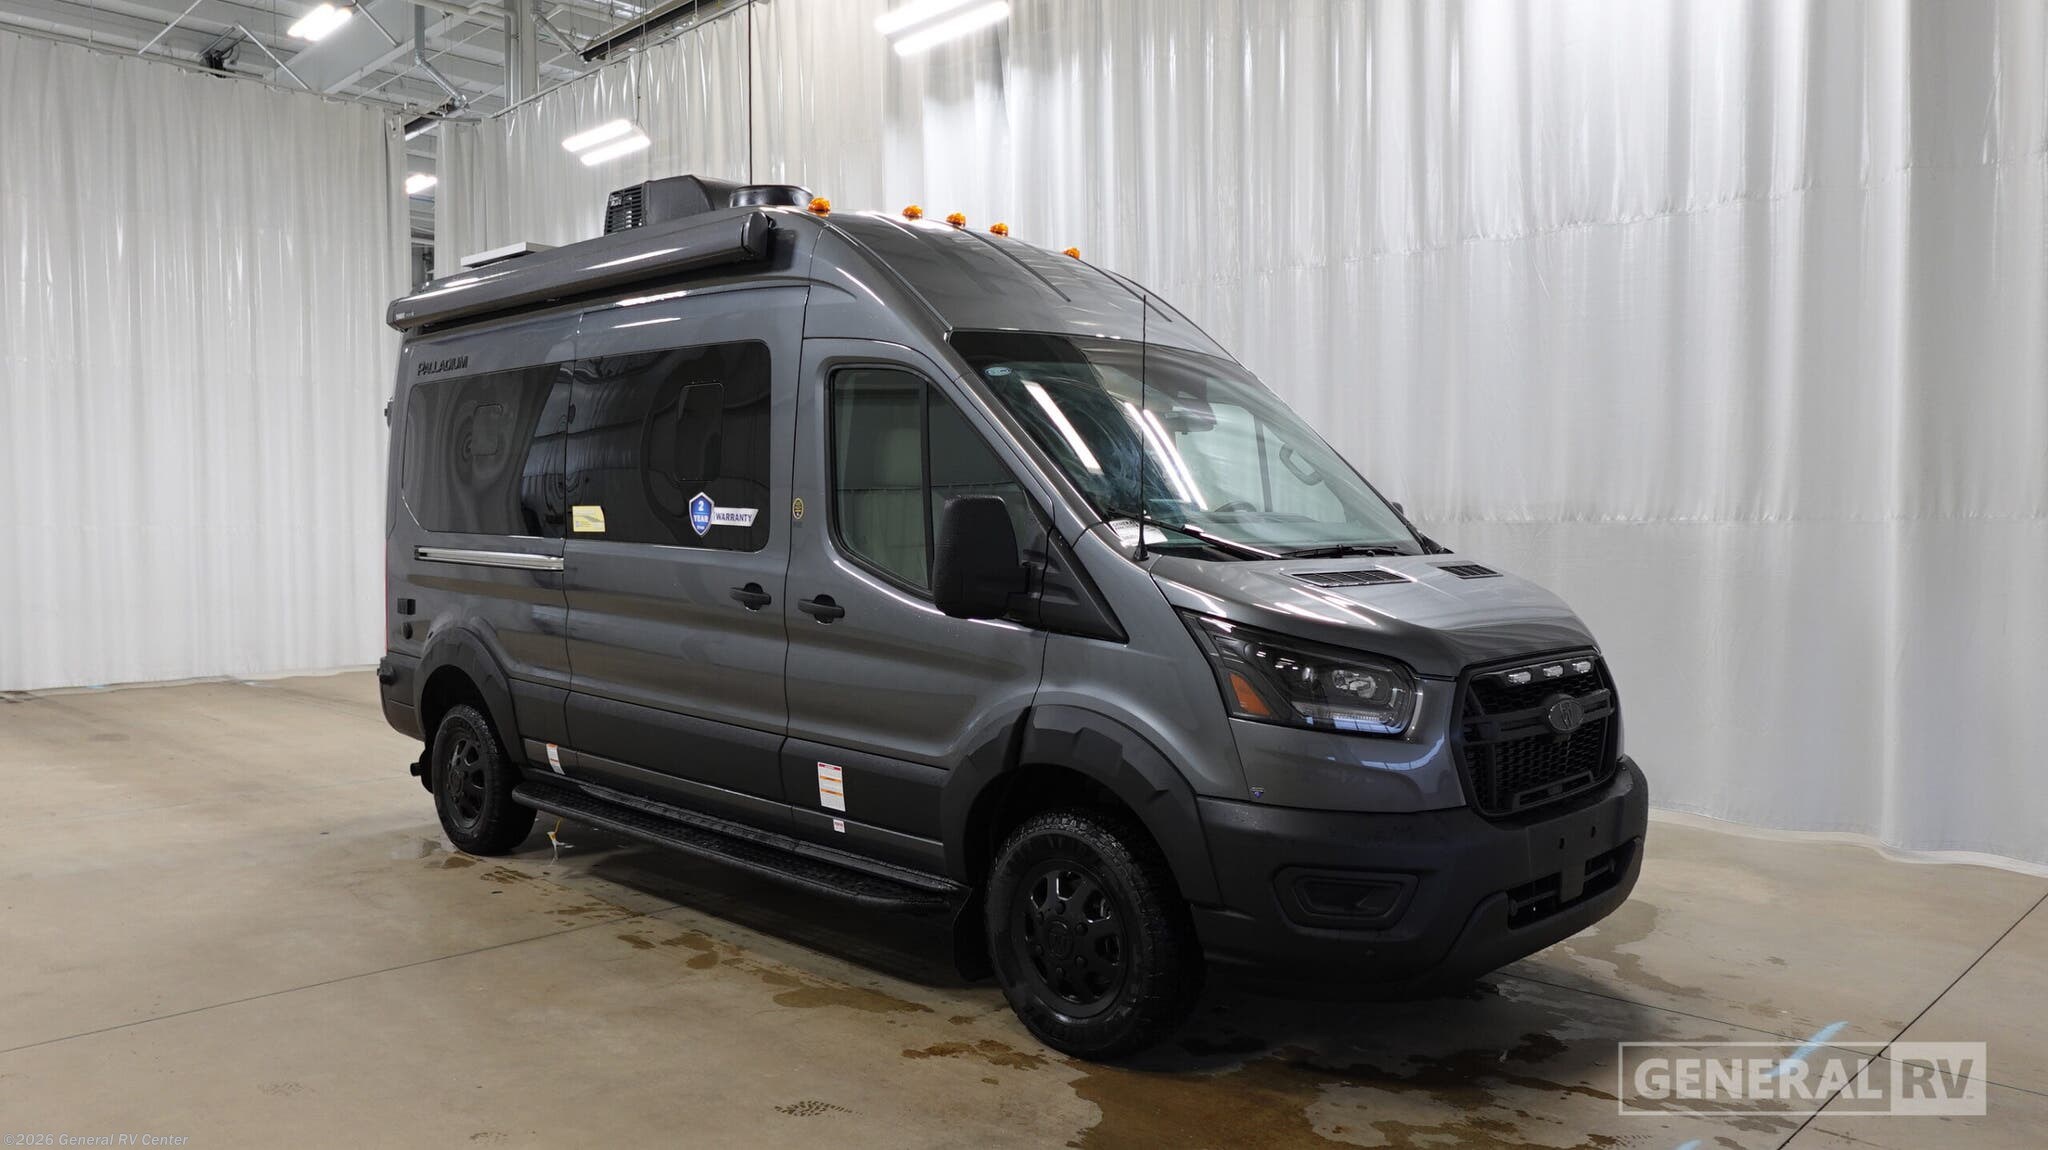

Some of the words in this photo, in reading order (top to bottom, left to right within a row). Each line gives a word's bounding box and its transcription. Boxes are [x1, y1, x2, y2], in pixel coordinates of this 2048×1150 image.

[417, 355, 469, 376] PALLADIUM
[698, 500, 705, 511] 2
[693, 514, 709, 523] YEAR
[715, 511, 753, 523] WARRANTY
